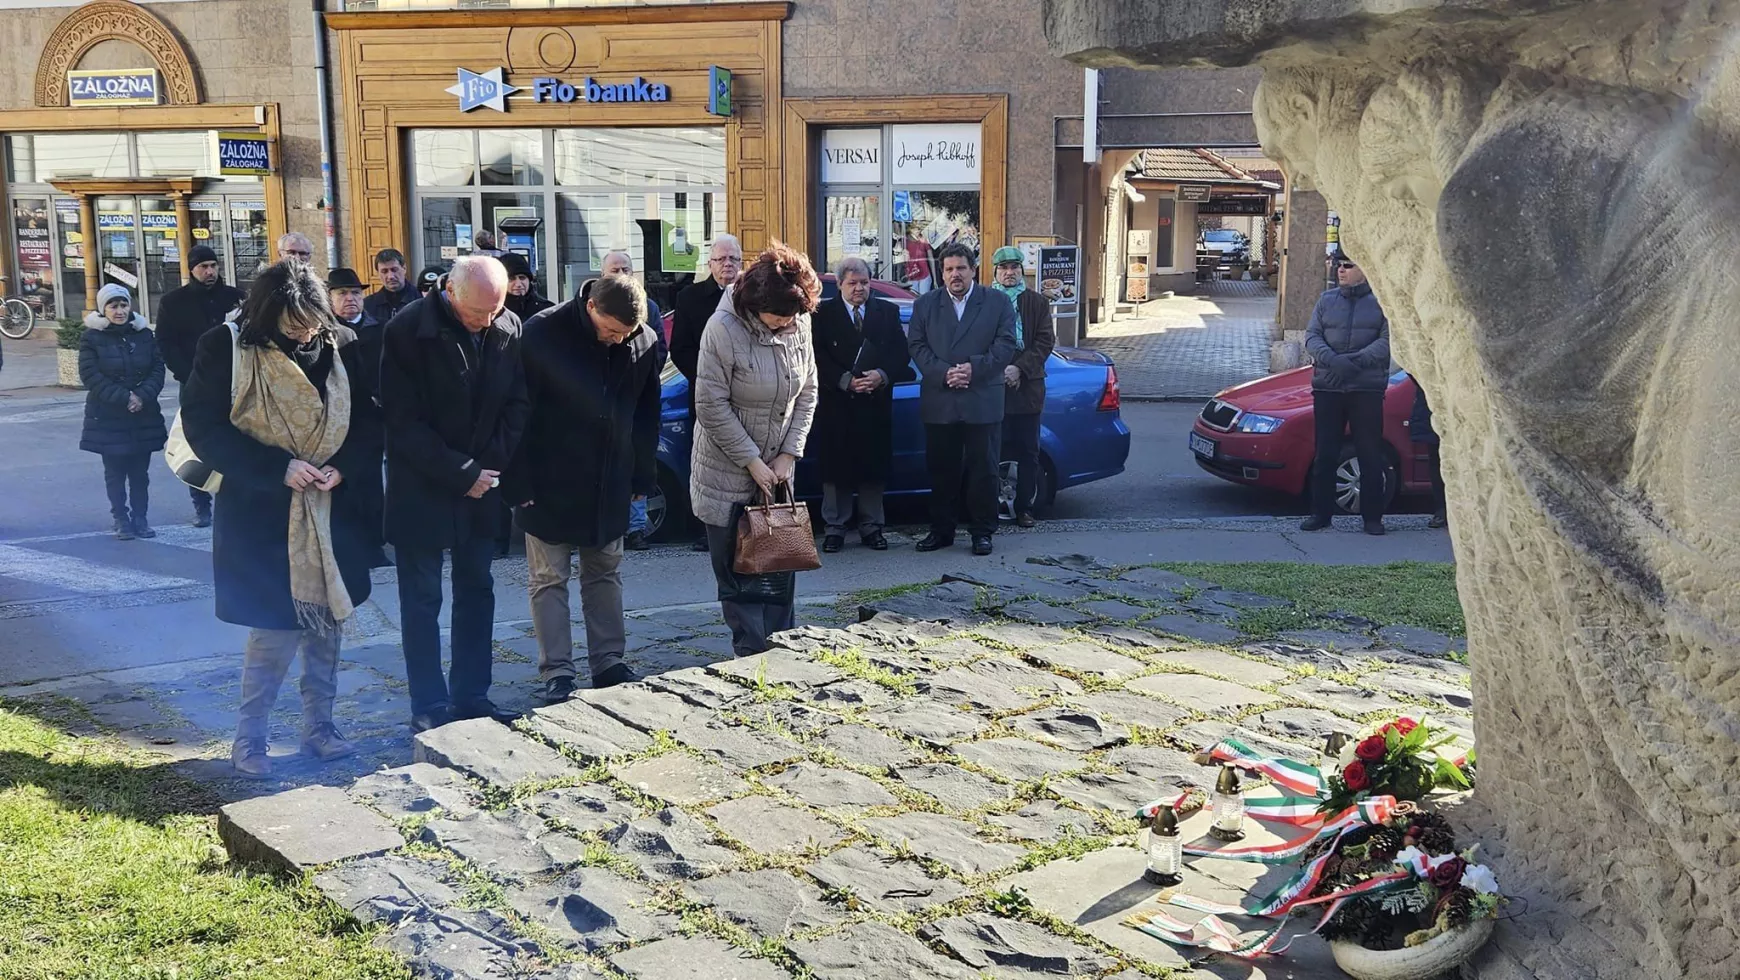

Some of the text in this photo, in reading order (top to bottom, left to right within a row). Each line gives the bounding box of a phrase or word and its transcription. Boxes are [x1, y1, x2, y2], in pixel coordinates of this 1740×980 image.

[73, 75, 153, 94] ZÁLOŽŇA
[467, 75, 494, 102] Fio
[532, 76, 667, 103] Fio banka
[220, 140, 268, 159] ZÁLOŽŇA
[825, 148, 878, 164] VERSAI
[897, 141, 935, 169] Joseph
[225, 159, 264, 168] ZÁLOGHÁZ
[99, 214, 134, 224] ZÁLOŽŇA
[142, 214, 177, 224] ZÁLOŽŇA
